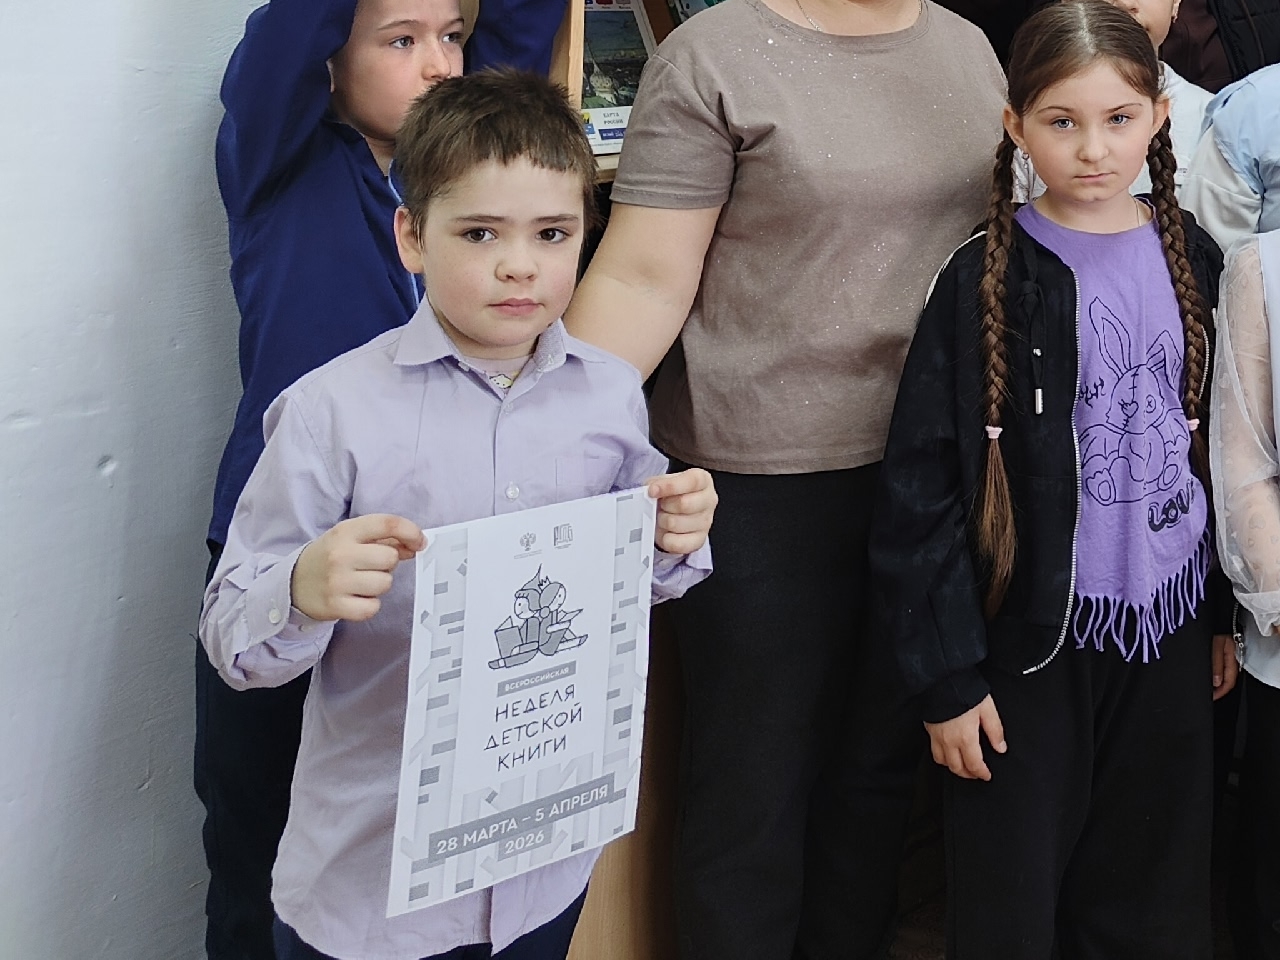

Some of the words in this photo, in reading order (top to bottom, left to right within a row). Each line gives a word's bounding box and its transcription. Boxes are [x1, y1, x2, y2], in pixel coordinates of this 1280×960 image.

[505, 666, 569, 693] ВСЕРОССИЙСКАЯ
[496, 684, 575, 722] НЕДЕЛЯ
[484, 701, 583, 751] ДЕТСКОЙ
[497, 734, 567, 772] КНИГИ
[436, 837, 458, 856] 28
[463, 816, 518, 849] МАРТА
[535, 807, 545, 823] 5
[548, 784, 609, 819] АПРЕЛЯ
[505, 829, 545, 856] 2026
